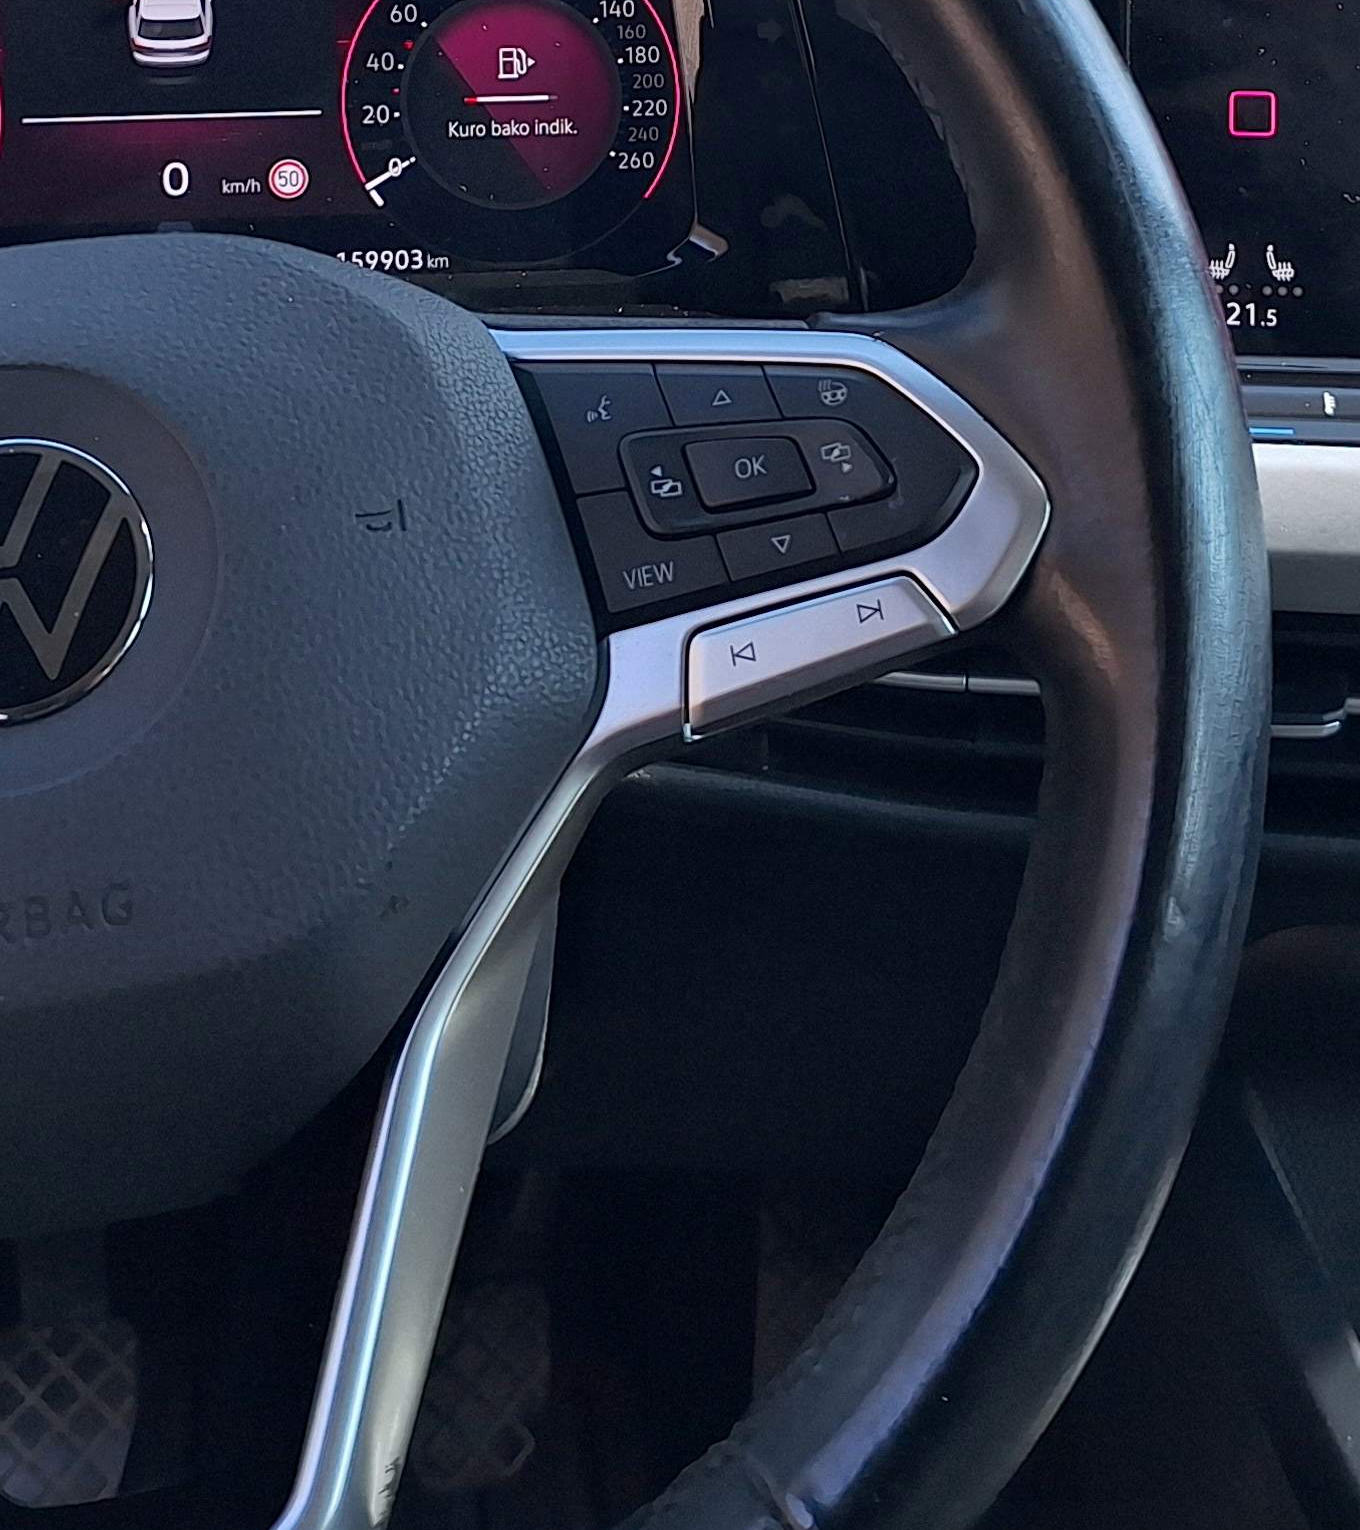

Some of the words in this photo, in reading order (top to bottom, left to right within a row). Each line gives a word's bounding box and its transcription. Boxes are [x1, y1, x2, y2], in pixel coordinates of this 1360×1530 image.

[390, 4, 418, 23] 60
[599, 0, 635, 19] 140
[617, 24, 647, 40] 160
[366, 53, 395, 72] 40
[626, 46, 660, 64] 180
[632, 73, 665, 89] 200
[362, 105, 390, 125] 20
[632, 99, 668, 117] 220
[448, 120, 487, 139] Kuro
[491, 119, 530, 138] bako
[534, 118, 577, 137] indik.
[628, 126, 659, 142] 240
[388, 157, 402, 177] 0
[618, 151, 655, 169] 260
[162, 162, 189, 196] 0
[222, 178, 261, 194] km/h
[278, 170, 299, 188] 50
[426, 253, 449, 269] km
[1226, 303, 1277, 328] 21.5
[734, 455, 767, 479] OK
[623, 562, 674, 590] VIEW
